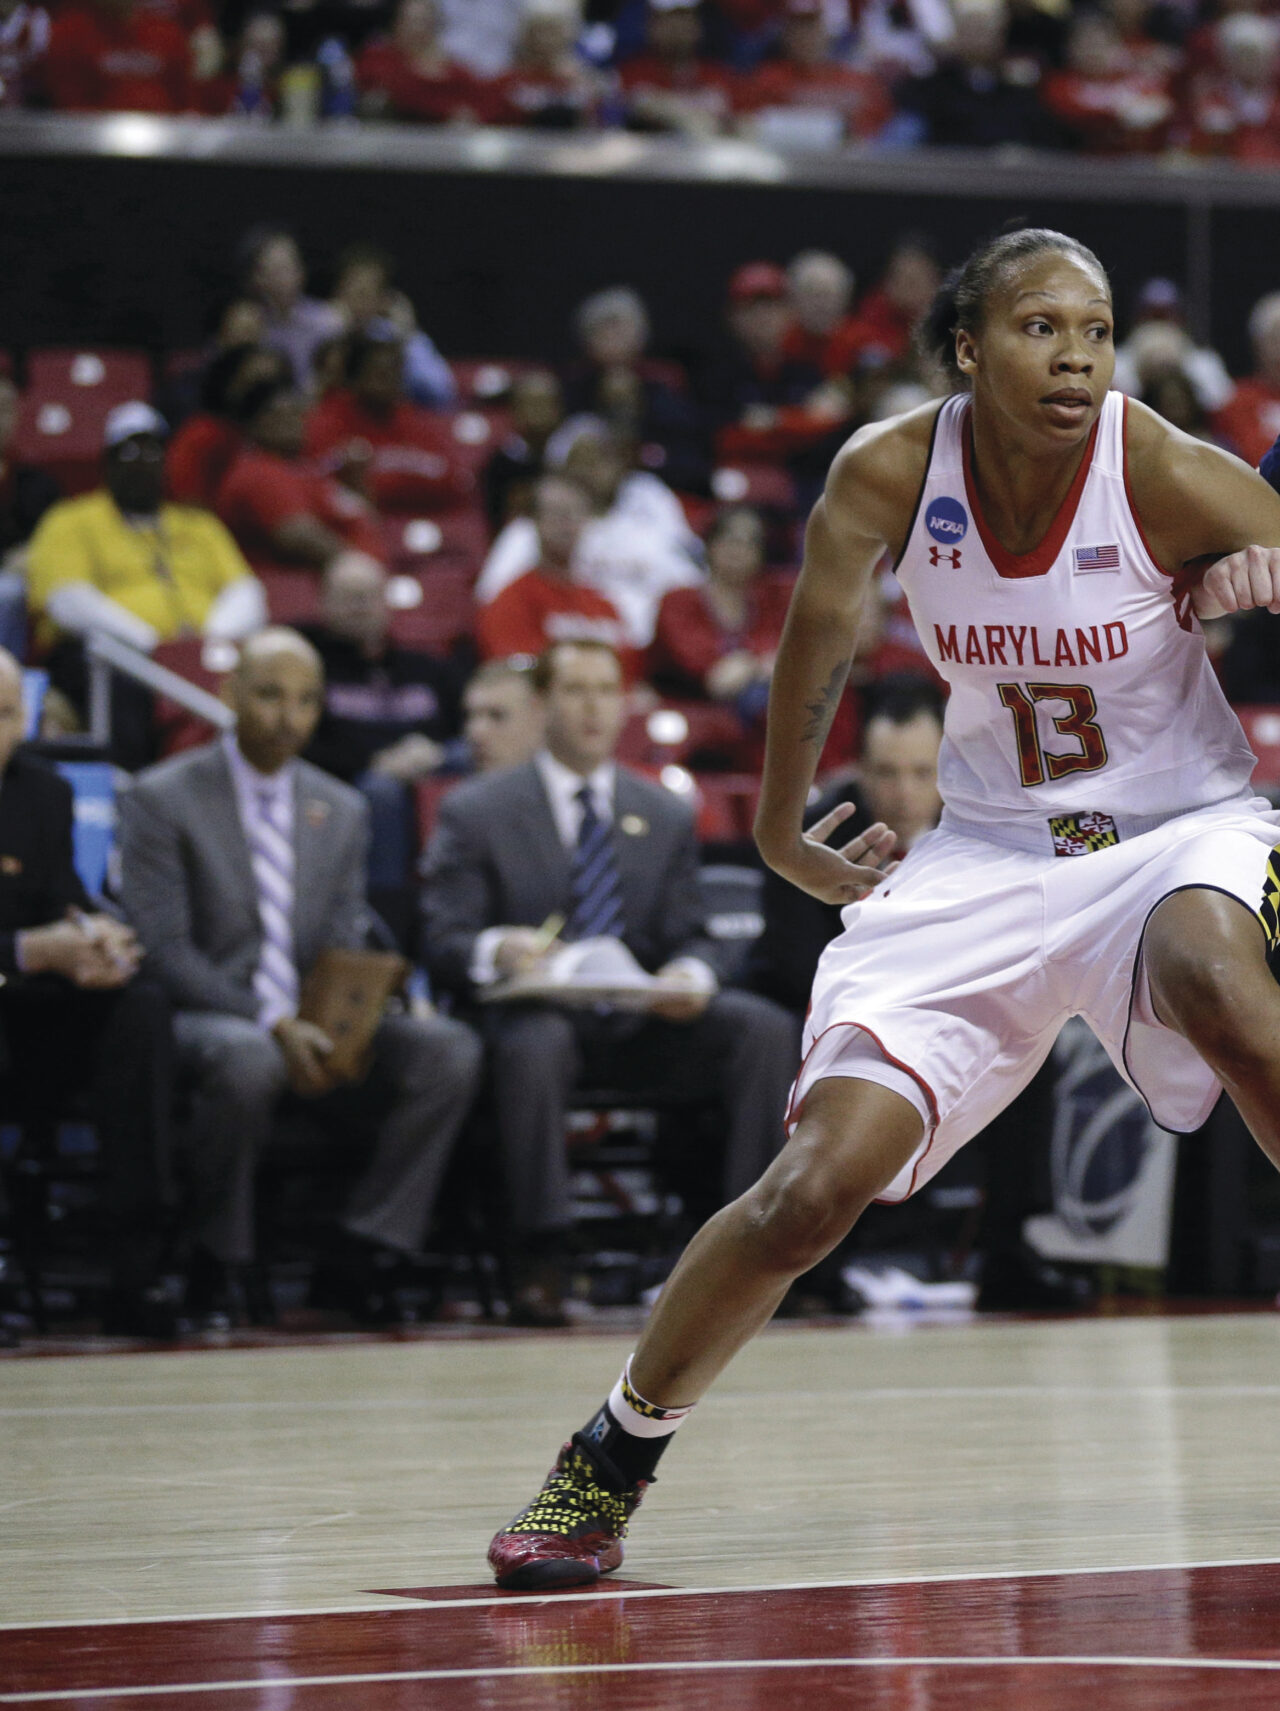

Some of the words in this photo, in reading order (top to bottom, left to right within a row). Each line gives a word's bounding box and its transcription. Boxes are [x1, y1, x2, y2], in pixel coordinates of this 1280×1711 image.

[930, 516, 964, 536] NCAA
[934, 621, 1129, 667] MARYLAND
[997, 682, 1108, 787] 13
